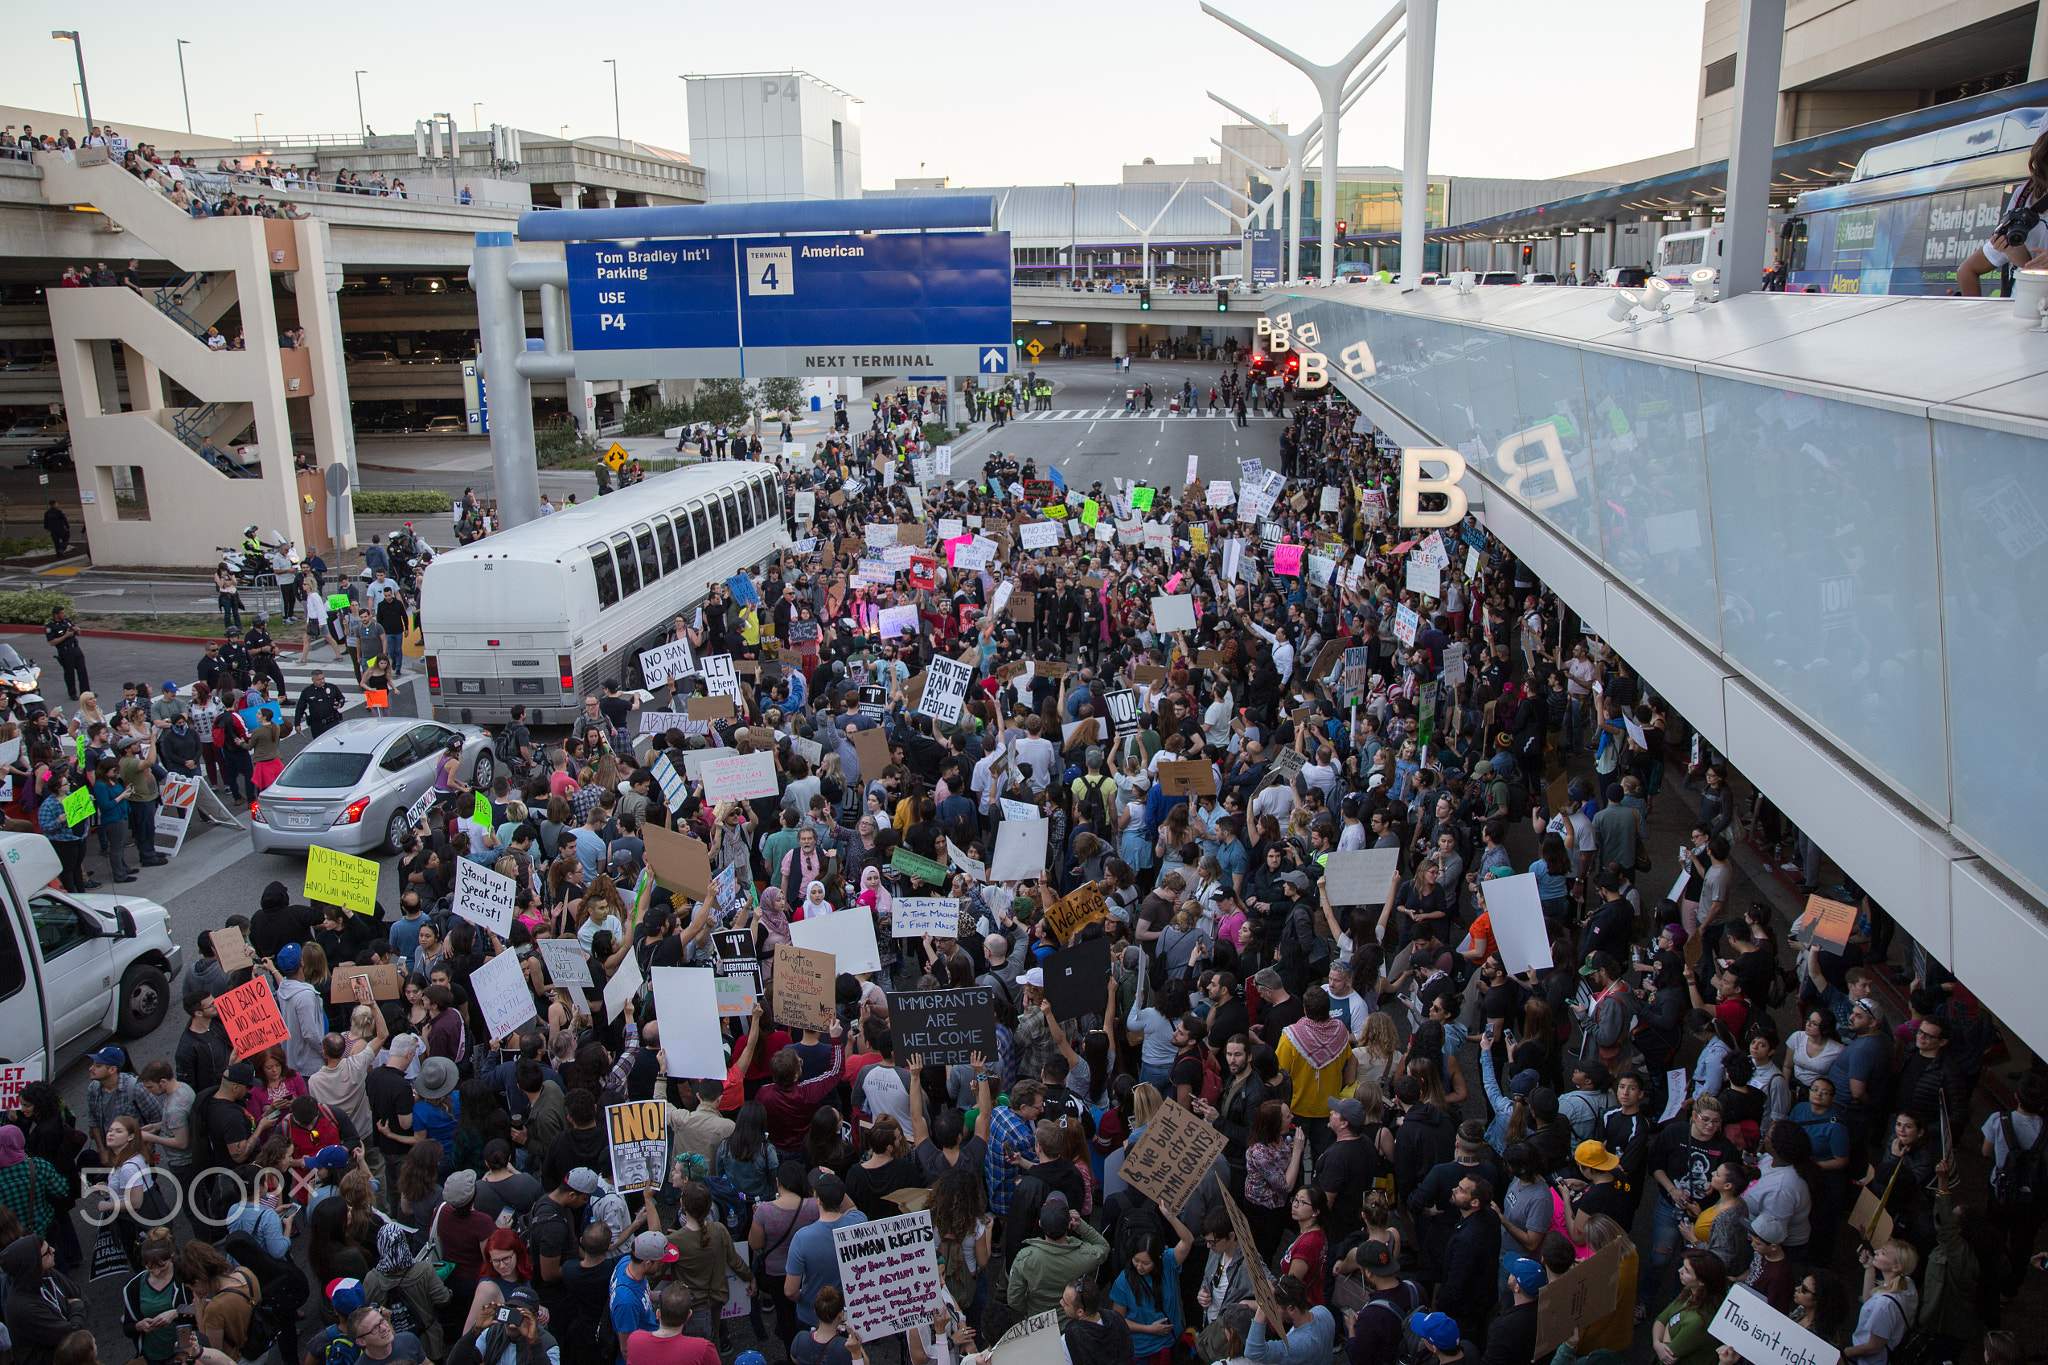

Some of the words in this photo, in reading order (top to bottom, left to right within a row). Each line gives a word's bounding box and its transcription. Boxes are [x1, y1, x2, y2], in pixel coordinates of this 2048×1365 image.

[762, 80, 798, 104] P4
[1930, 204, 1974, 232] Sharing
[1845, 219, 1875, 241] National
[596, 252, 623, 264] Tom
[628, 250, 677, 267] Bradley
[682, 248, 710, 262] Int'l
[750, 252, 788, 260] TERMINAL
[801, 246, 864, 259] American
[1926, 240, 1945, 261] the
[597, 267, 648, 280] Parking
[761, 263, 779, 290] 4
[1830, 274, 1858, 294] Alamo
[599, 292, 626, 304] USE
[600, 313, 626, 331] P4
[1258, 318, 1272, 336] B
[1271, 329, 1290, 352] B
[805, 354, 846, 368] NEXT
[852, 353, 934, 366] TERMINAL
[1299, 352, 1329, 389] B
[1398, 446, 1468, 529] B
[1022, 526, 1038, 534] #NO
[1041, 524, 1055, 533] BAN
[1024, 533, 1056, 545] #RESIST
[645, 652, 662, 668] NO
[664, 644, 686, 661] BAN
[1346, 650, 1355, 668] NO
[646, 668, 662, 685] NO
[664, 658, 693, 676] WALL
[704, 655, 731, 678] LET
[932, 658, 952, 674] END
[952, 664, 970, 682] THE
[712, 680, 734, 690] them
[928, 673, 949, 692] BAN
[951, 680, 967, 697] ON
[1346, 668, 1356, 689] NO
[926, 690, 941, 700] MY
[921, 698, 956, 720] PEOPLE
[1107, 692, 1136, 723] NO!
[716, 771, 762, 784] AMERICAN
[407, 808, 418, 826] NO
[6, 848, 20, 864] 56
[312, 847, 328, 864] NO
[330, 855, 355, 872] Human
[358, 860, 376, 882] Being
[340, 870, 369, 889] Illegal
[461, 862, 487, 886] Stand
[490, 878, 507, 892] up!
[305, 881, 322, 894] #NO
[461, 877, 490, 898] Speak
[492, 891, 512, 909] out!
[460, 895, 500, 922] Resist!
[899, 899, 912, 908] YOU
[939, 900, 957, 908] NEED
[910, 910, 927, 918] TIME
[930, 910, 958, 918] MACHINE
[1049, 893, 1104, 935] Welcome
[896, 921, 905, 929] TO
[910, 920, 930, 928] FIGHT
[934, 920, 956, 932] NAZIS
[541, 942, 568, 956] They
[555, 960, 573, 970] NOT
[780, 950, 813, 968] Christian
[473, 955, 516, 989] MARCHING
[577, 972, 590, 980] US
[780, 972, 796, 984] What
[798, 973, 814, 986] Would
[371, 978, 390, 987] WALL
[715, 980, 740, 993] The
[482, 978, 524, 1007] PROTESTING
[898, 992, 988, 1011] IMMIGRANTS
[217, 998, 233, 1022] NO
[238, 985, 257, 1009] BAN
[490, 994, 524, 1024] UNTIL
[820, 1002, 834, 1014] NOT
[236, 1013, 248, 1033] NO
[251, 1004, 270, 1024] WALL
[493, 1020, 511, 1036] JAN
[926, 1012, 957, 1028] ARE
[235, 1028, 266, 1056] SANCTUARY
[272, 1018, 288, 1040] ALL!
[902, 1030, 984, 1047] WELCOME
[922, 1049, 969, 1066] HERE
[1151, 1116, 1179, 1148] built
[1150, 1161, 1171, 1184] this
[1168, 1135, 1188, 1160] city
[1184, 1121, 1199, 1137] on
[836, 1231, 851, 1242] THE
[851, 1224, 878, 1240] UNIVERSAL
[881, 1216, 917, 1234] DECLARATION
[919, 1215, 926, 1225] OF
[839, 1238, 886, 1264] HUMAN
[888, 1226, 934, 1250] RIGHTS
[846, 1283, 856, 1294] to
[879, 1268, 914, 1285] ASYLUM
[917, 1265, 930, 1275] in
[850, 1294, 881, 1307] another
[1727, 1299, 1750, 1332] This
[1751, 1324, 1781, 1351] isn't
